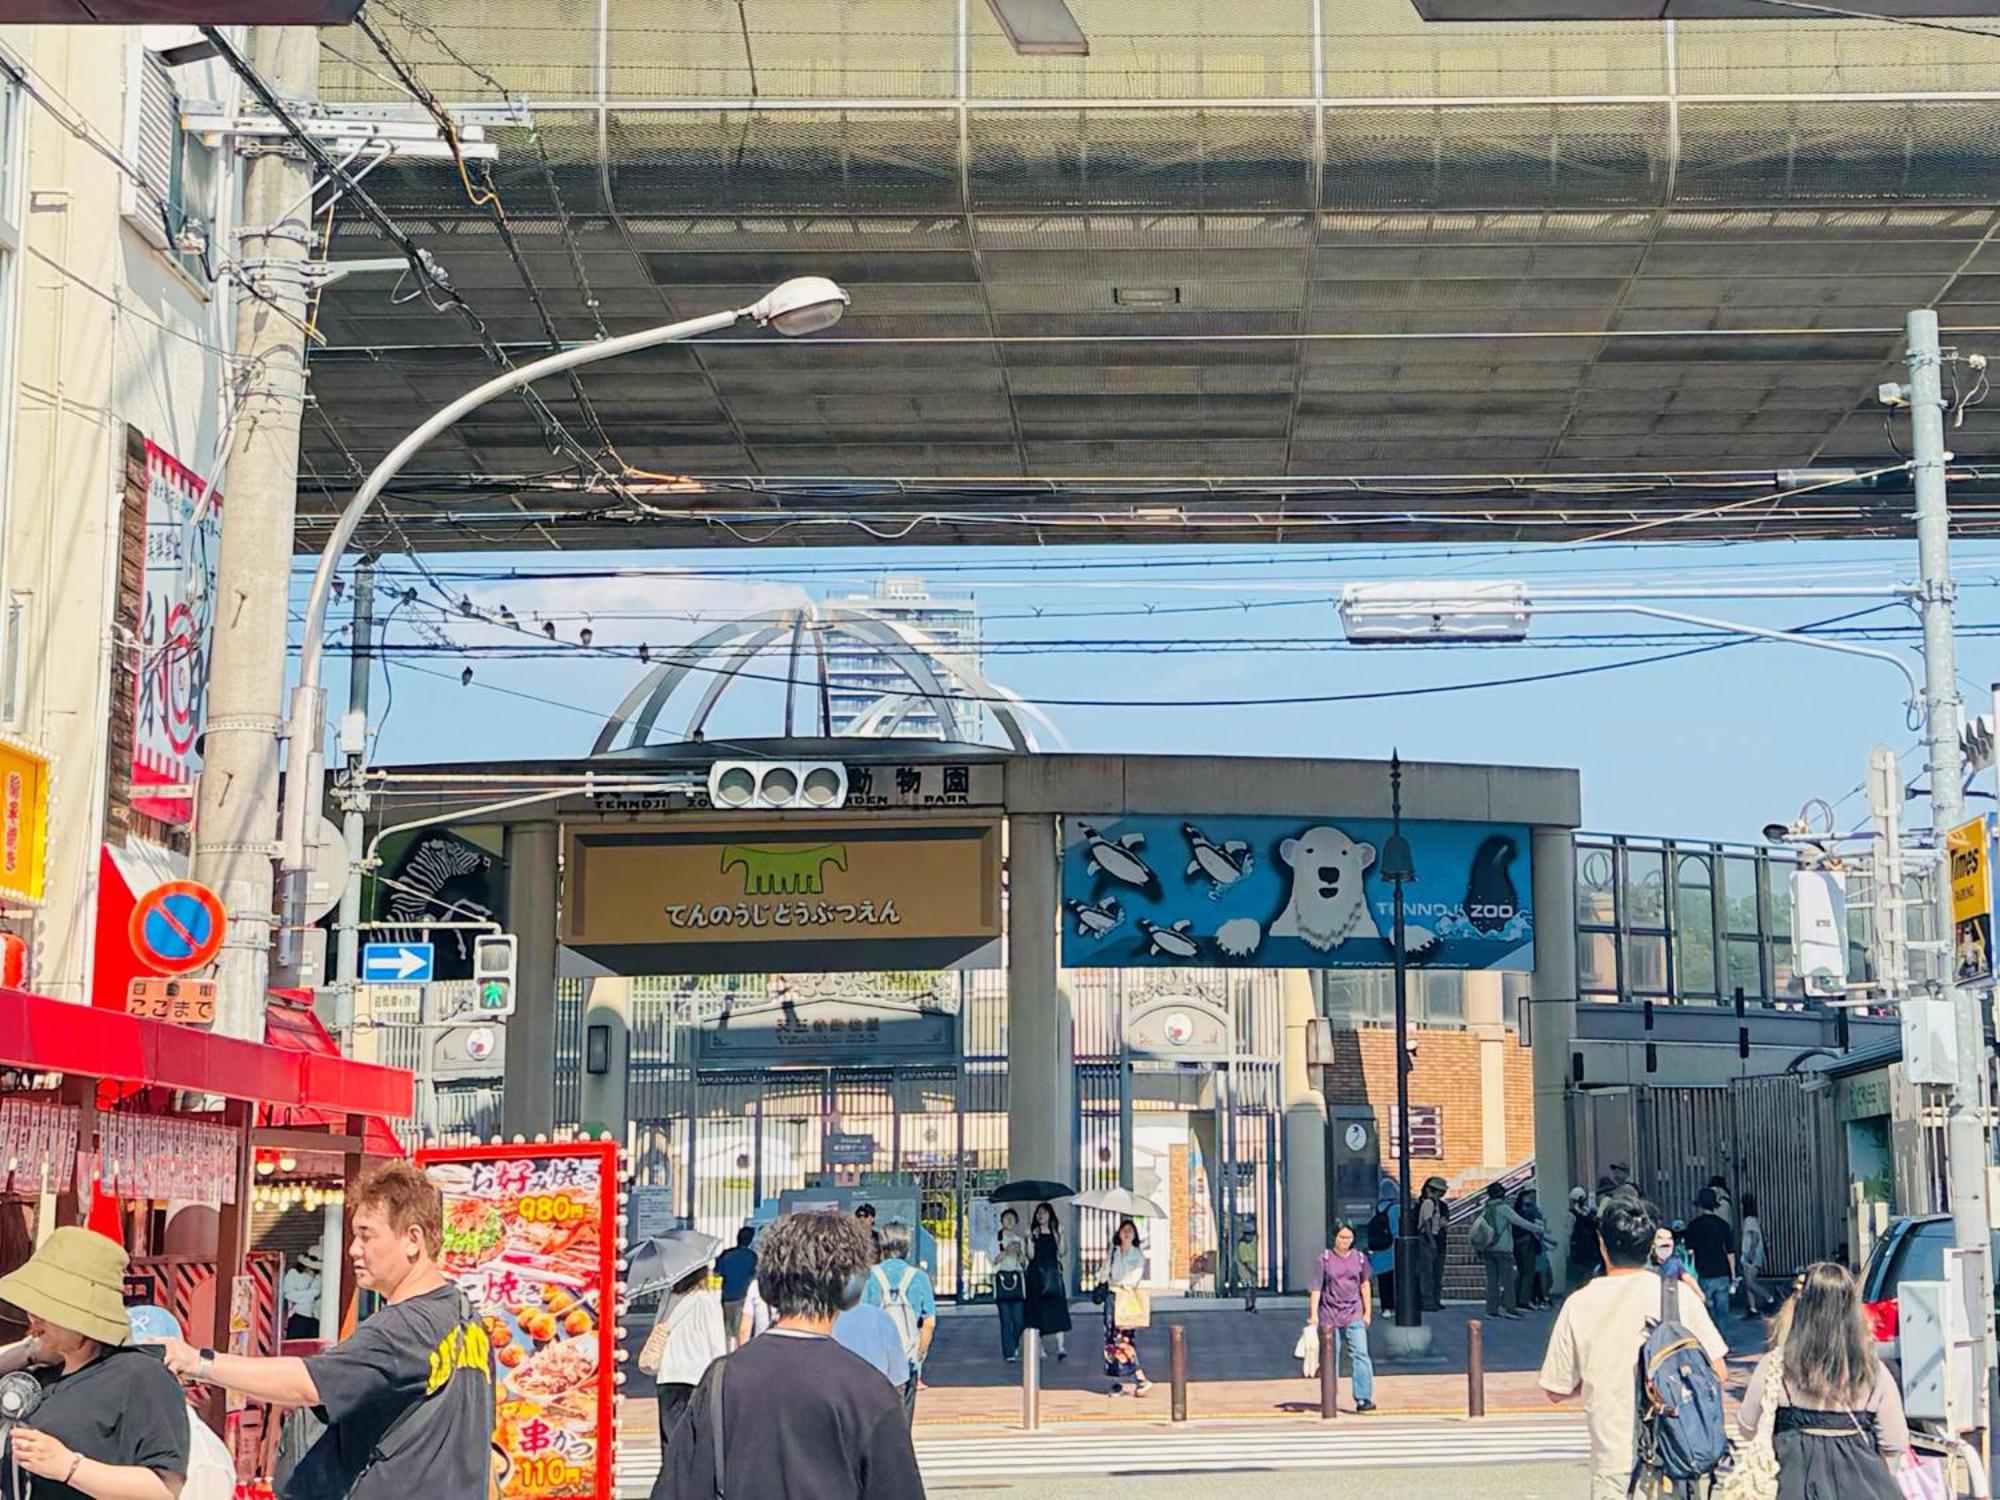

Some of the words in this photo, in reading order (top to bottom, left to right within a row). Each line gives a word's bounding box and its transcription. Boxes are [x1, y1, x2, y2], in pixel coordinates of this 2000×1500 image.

[595, 799, 666, 810] TENNOJI
[925, 794, 969, 804] PARK
[666, 901, 900, 927] てんのうじどうぶつえん
[1377, 901, 1464, 917] TNNOJI
[1470, 904, 1514, 918] ZOO
[131, 999, 212, 1018] ここまで
[472, 1160, 598, 1193] お好み焼き
[520, 1419, 593, 1456] 串かつ
